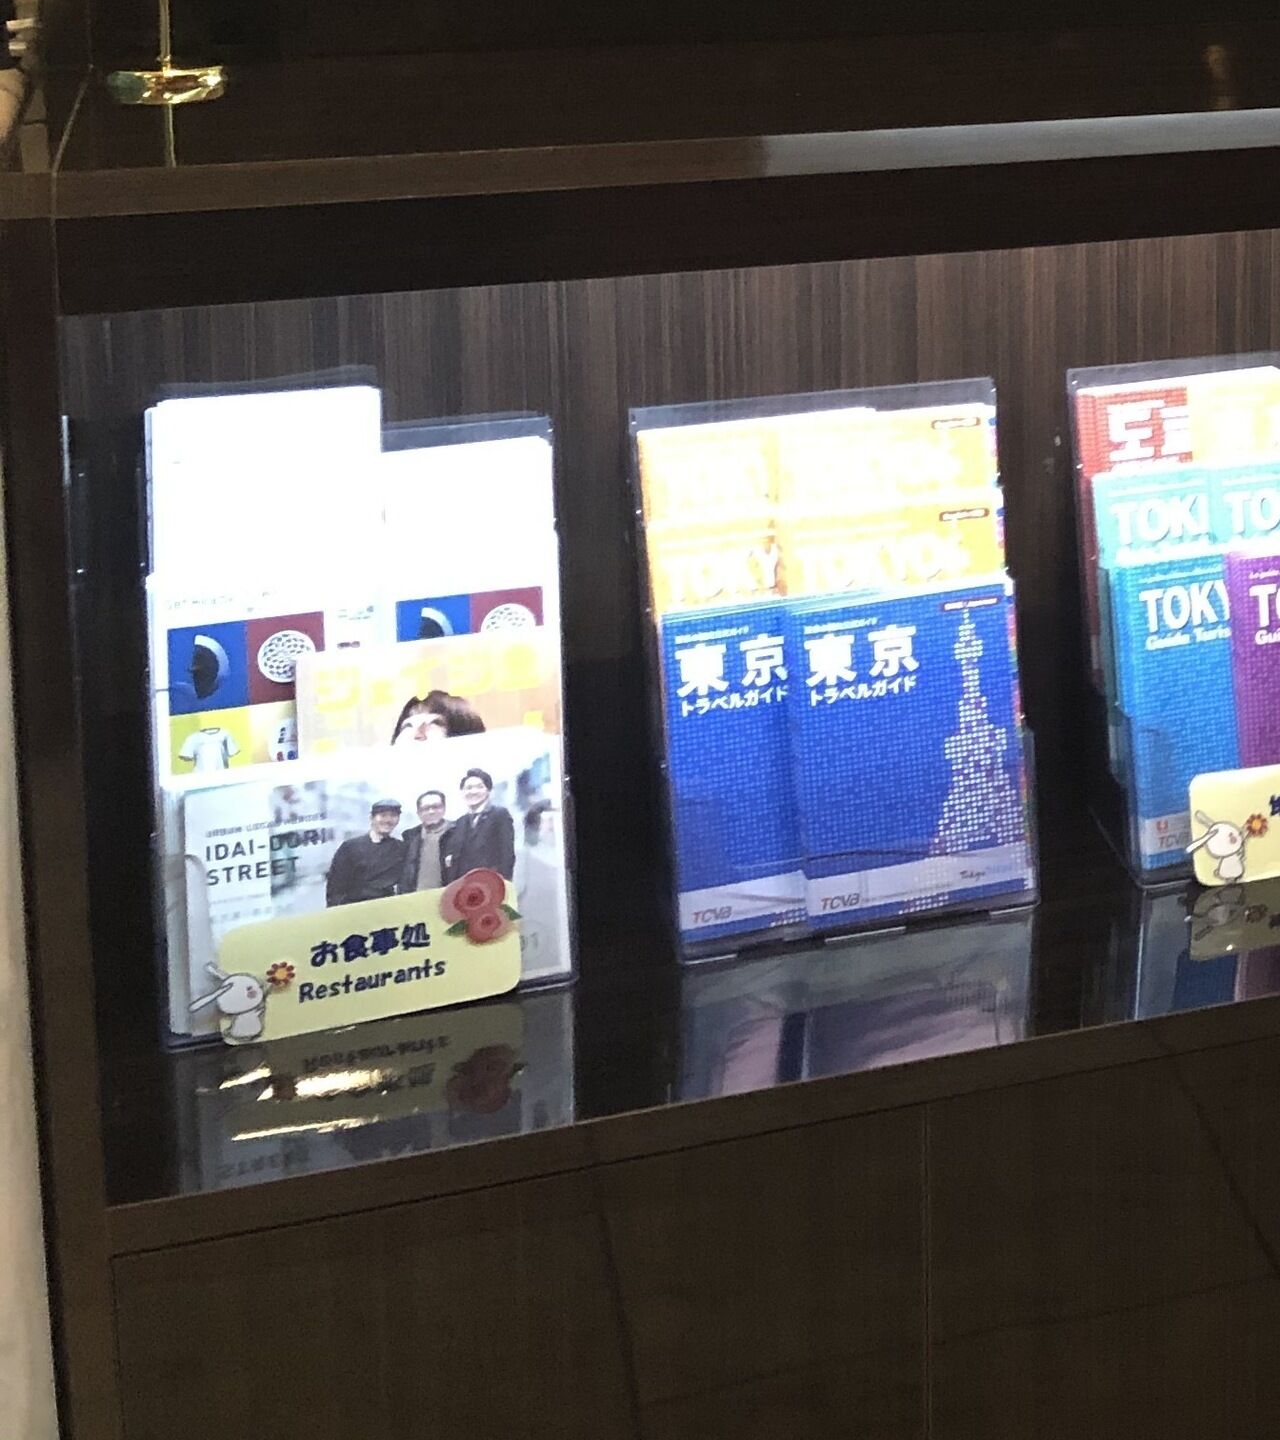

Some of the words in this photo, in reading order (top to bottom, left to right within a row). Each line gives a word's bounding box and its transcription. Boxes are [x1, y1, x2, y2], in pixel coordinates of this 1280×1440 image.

[675, 633, 789, 698] 東京
[804, 624, 920, 687] 東京
[681, 685, 789, 718] トラベルガイド
[810, 675, 918, 707] トラベルガイド
[207, 856, 299, 886] STREET
[310, 922, 431, 968] お食事処
[298, 958, 447, 1004] Restaurants
